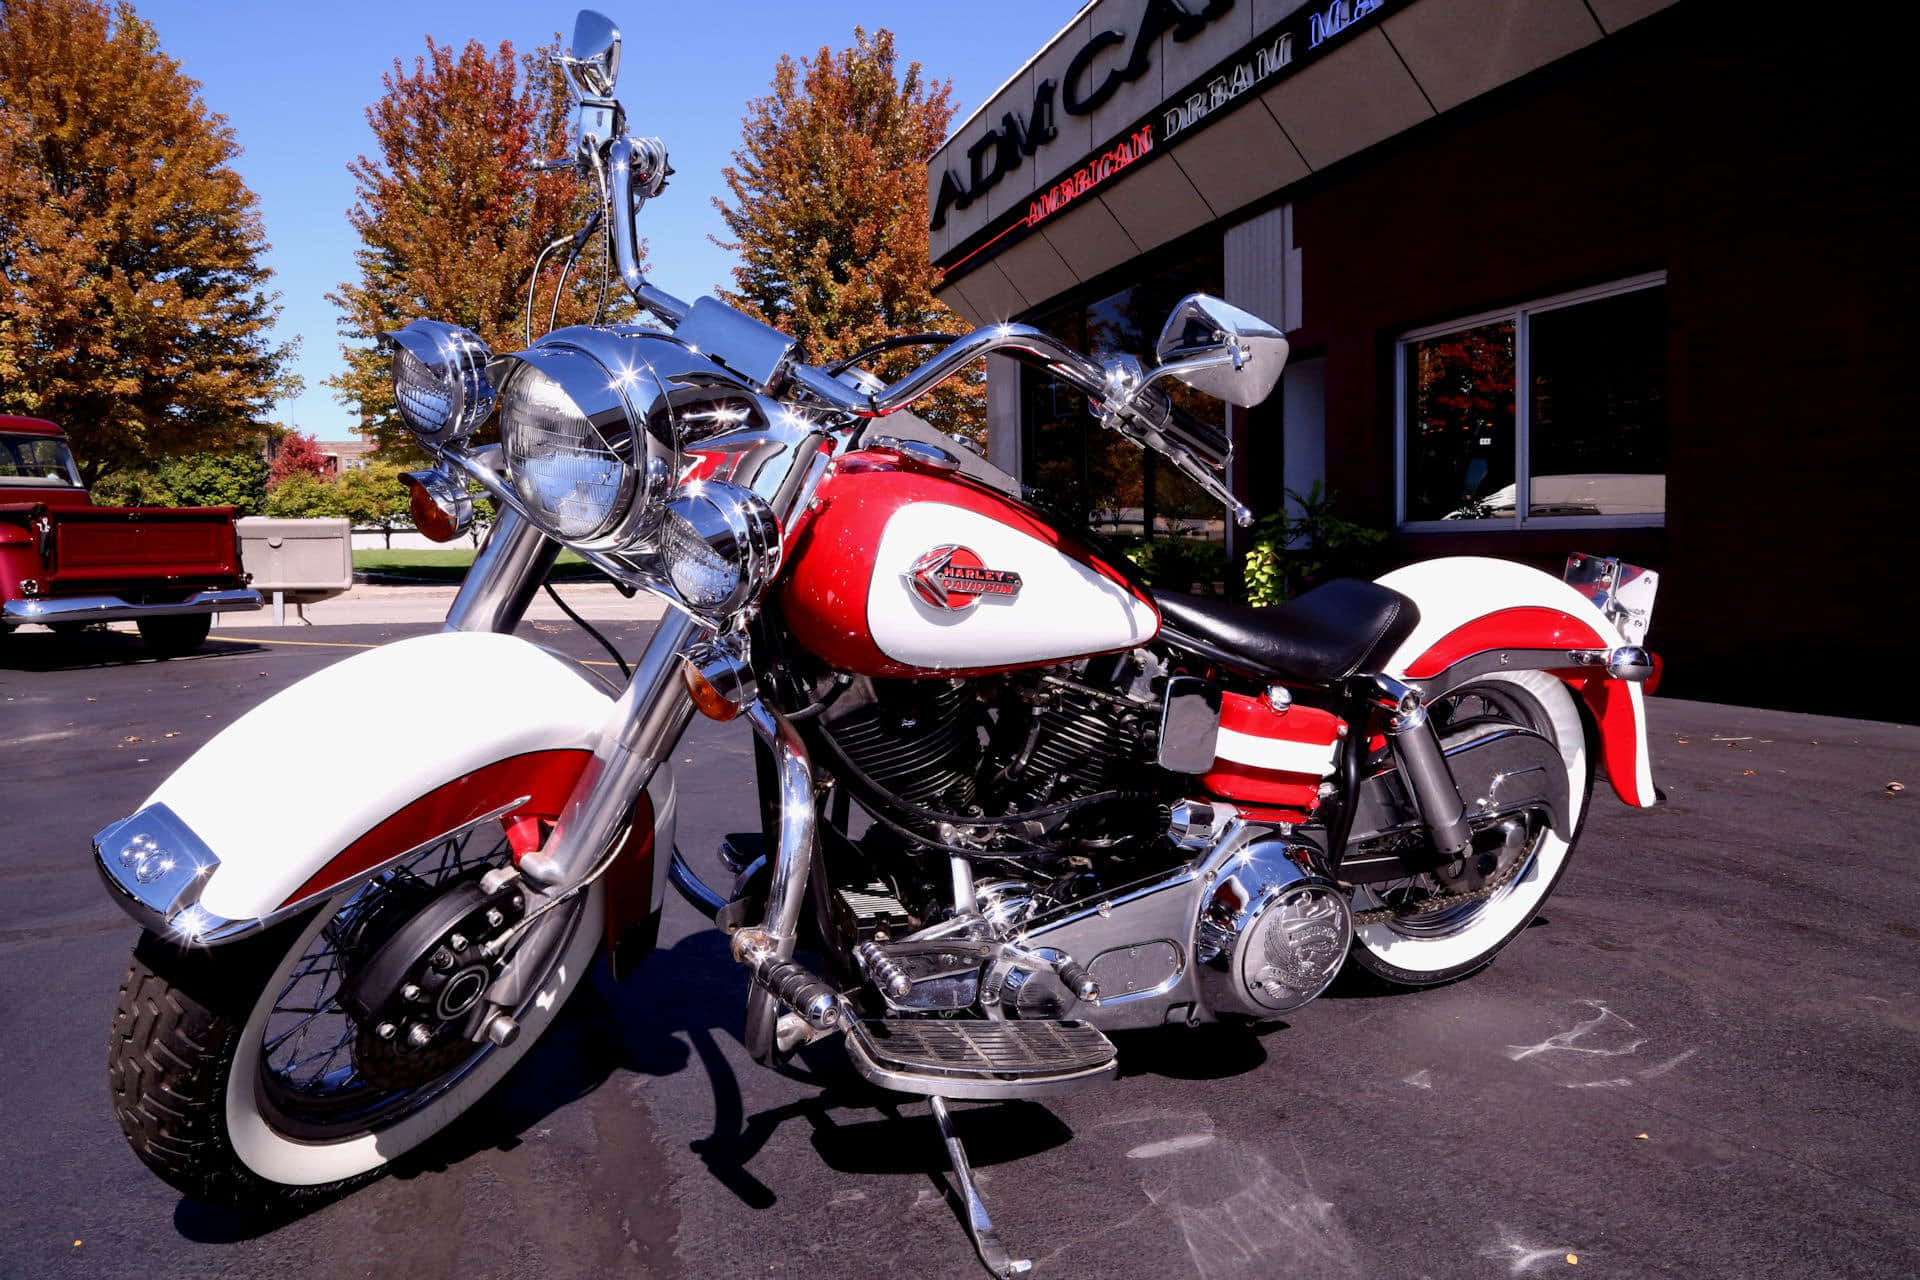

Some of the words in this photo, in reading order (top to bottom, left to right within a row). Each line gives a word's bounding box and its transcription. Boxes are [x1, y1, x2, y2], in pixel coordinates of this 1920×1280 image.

[929, 0, 1236, 231] ADMCA
[1025, 124, 1154, 228] AMERICAN
[1162, 32, 1294, 142] DREAM
[942, 579, 1014, 595] DAVIDSON
